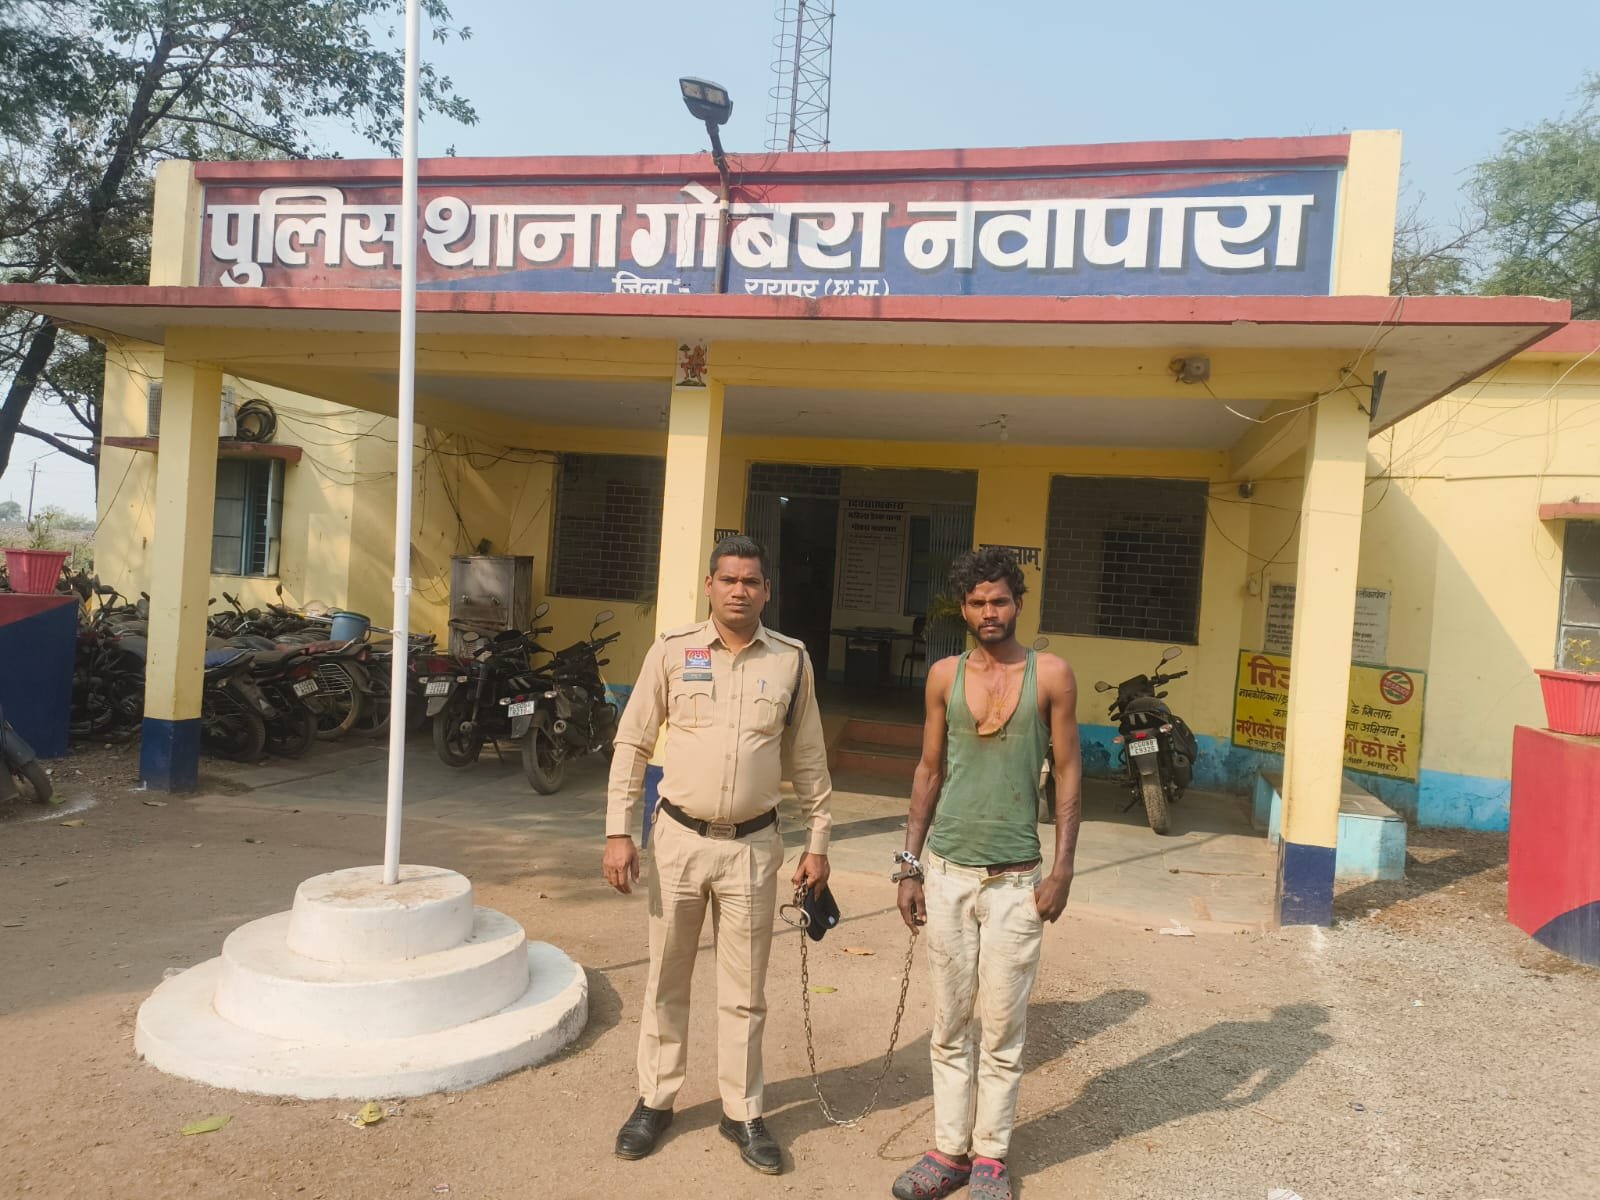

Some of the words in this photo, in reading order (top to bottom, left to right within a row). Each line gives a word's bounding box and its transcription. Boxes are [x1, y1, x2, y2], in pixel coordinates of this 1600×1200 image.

[207, 186, 402, 288] पुलिस
[423, 196, 622, 269] थाना
[631, 181, 889, 269] गोबरा
[904, 194, 1315, 269] नवापारा
